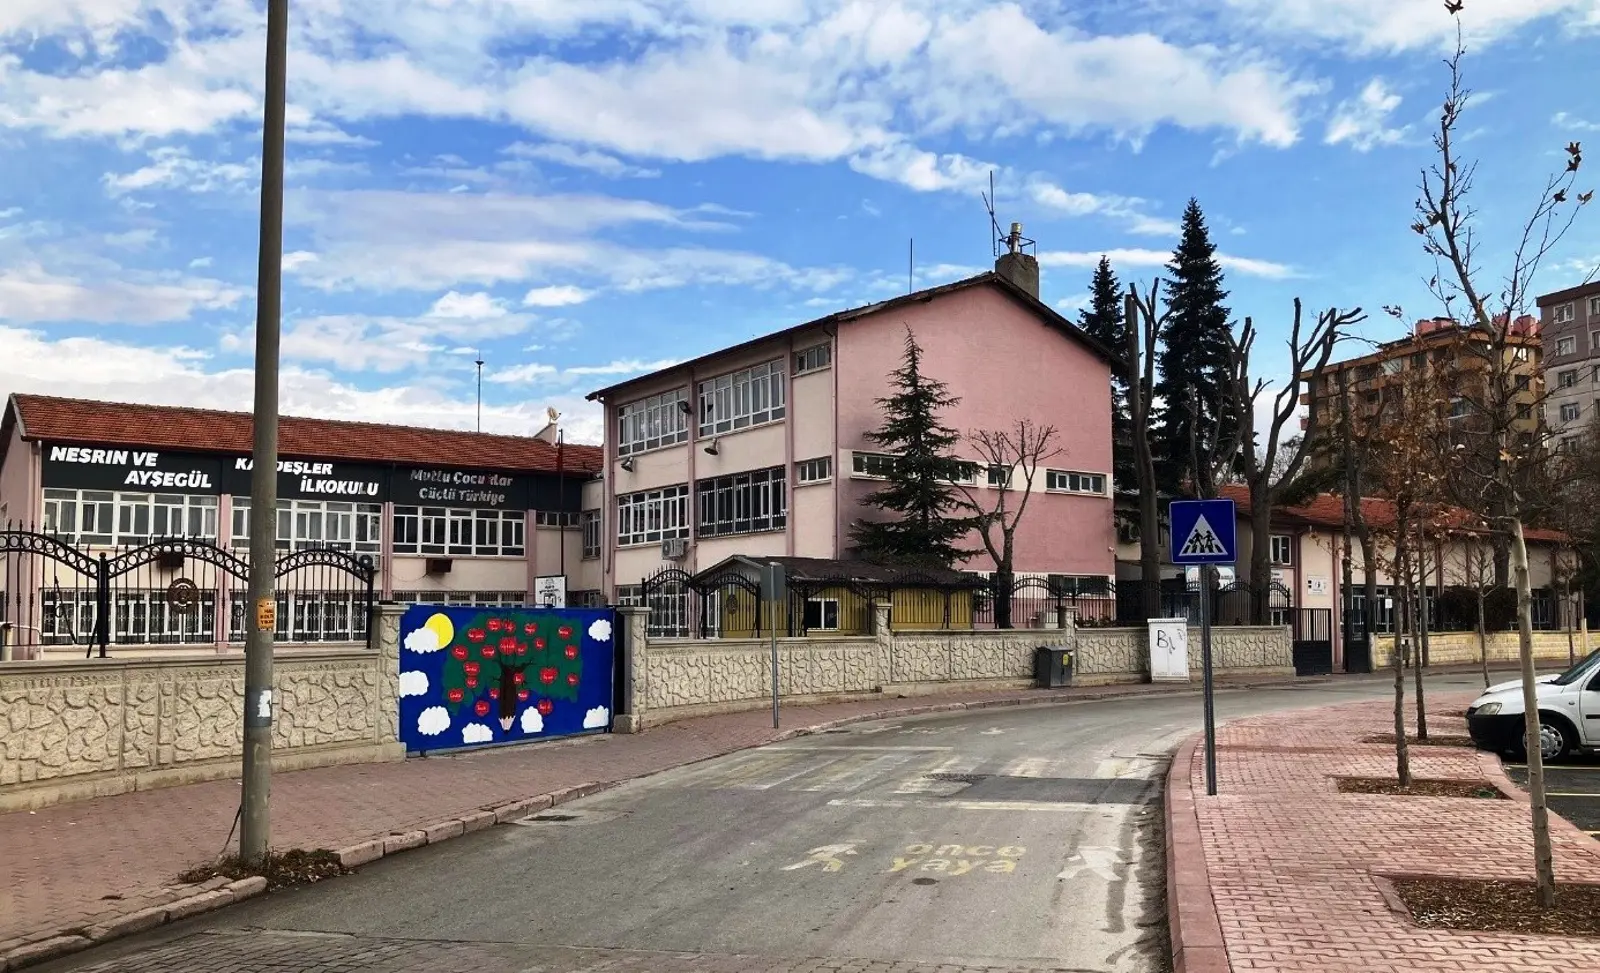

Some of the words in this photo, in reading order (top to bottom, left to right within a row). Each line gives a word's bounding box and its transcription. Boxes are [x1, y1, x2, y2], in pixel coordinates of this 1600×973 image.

[132, 452, 158, 467] VE
[124, 470, 213, 488] AYŞEGÜL
[410, 469, 450, 483] Mutlu
[300, 475, 379, 496] İLKOKULU
[459, 489, 506, 506] Türkiye
[887, 857, 1017, 877] yaya
